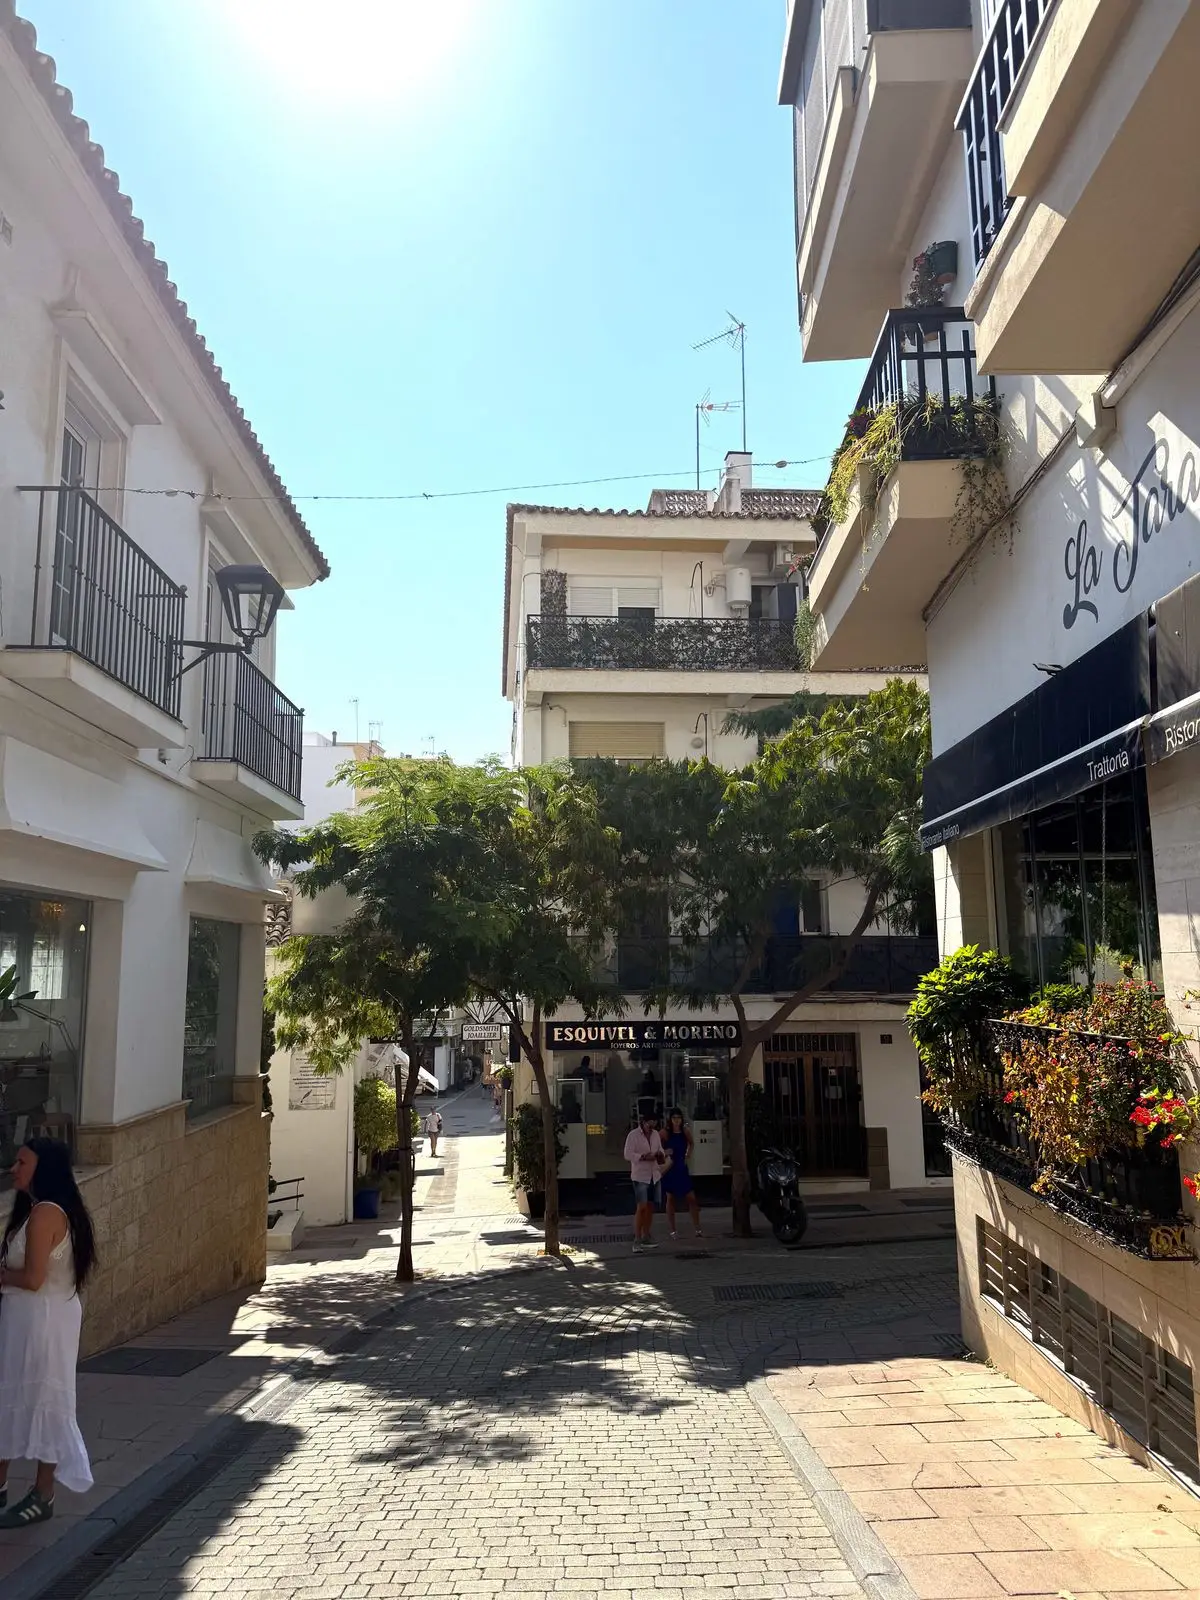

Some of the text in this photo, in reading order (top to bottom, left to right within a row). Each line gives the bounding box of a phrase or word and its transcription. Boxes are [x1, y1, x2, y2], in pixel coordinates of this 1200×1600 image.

[1063, 519, 1103, 630] La
[1087, 749, 1129, 781] Trattoria
[553, 1025, 737, 1043] ESQUIVEL & MORENO
